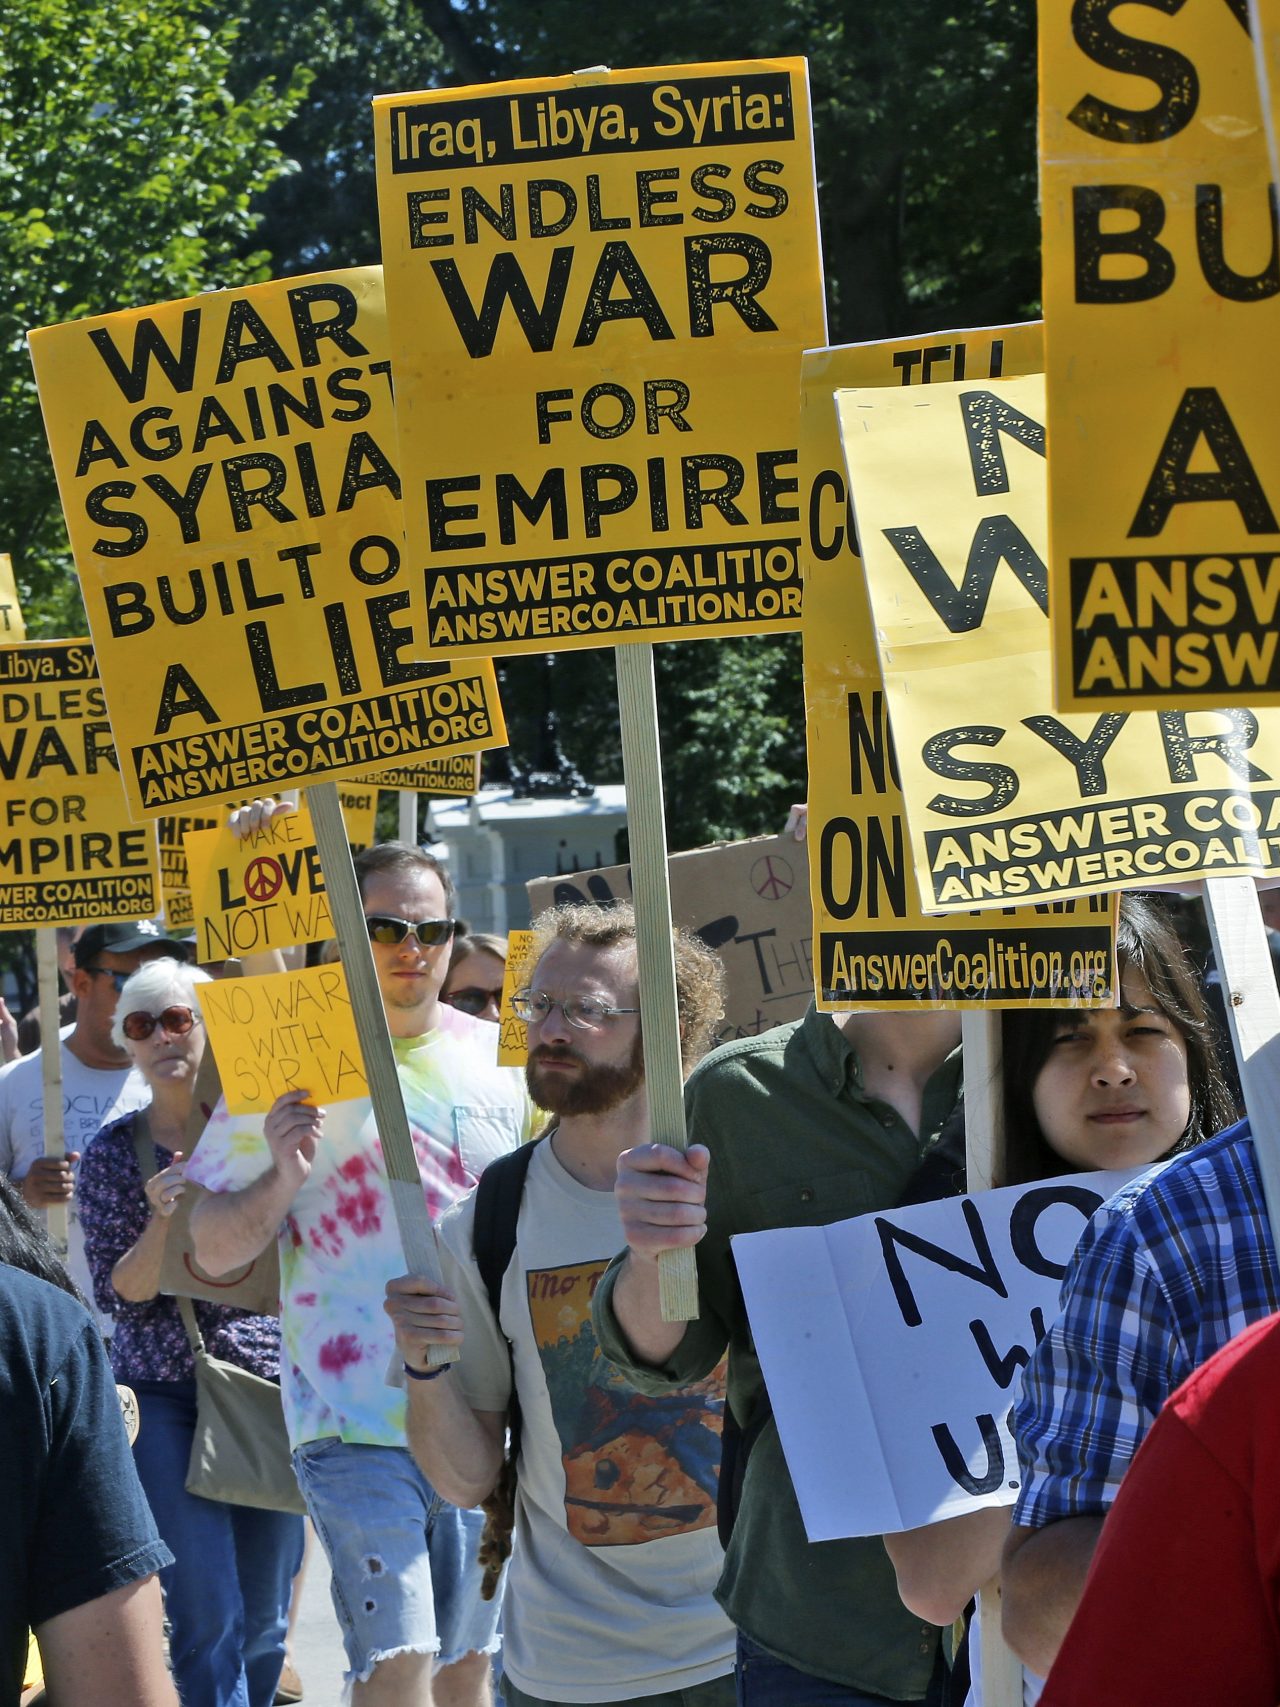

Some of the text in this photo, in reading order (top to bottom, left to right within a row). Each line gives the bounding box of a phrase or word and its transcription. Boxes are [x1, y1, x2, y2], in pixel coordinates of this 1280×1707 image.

[1066, 0, 1255, 144] S
[398, 85, 785, 163] Iraq, Libya, Syria:
[406, 160, 789, 249] ENDLESS
[430, 232, 779, 359] WAR
[87, 283, 370, 404] WAR
[536, 379, 693, 444] FOR
[85, 431, 402, 558] SYRIA
[426, 449, 800, 552] EMPIRE
[103, 535, 406, 638] BUILT O
[428, 545, 801, 609] ANSWER COALITIO
[153, 590, 451, 736] A LIE
[139, 680, 484, 779] ANSWER COALITION
[144, 711, 489, 806] ANSWERCOALITION.ORG
[6, 795, 86, 827] FOR
[239, 815, 302, 852] MAKE
[932, 803, 1167, 873] ANSWER
[42, 877, 150, 902] COALITION
[820, 815, 907, 921] ON
[0, 898, 153, 922] ERCOALITION.ORG
[204, 903, 278, 960] NOT
[204, 971, 351, 1025] NO WAR
[830, 938, 1107, 997] AnswerCoalition.org
[248, 1020, 331, 1058] WITH
[874, 1185, 1105, 1327] NO
